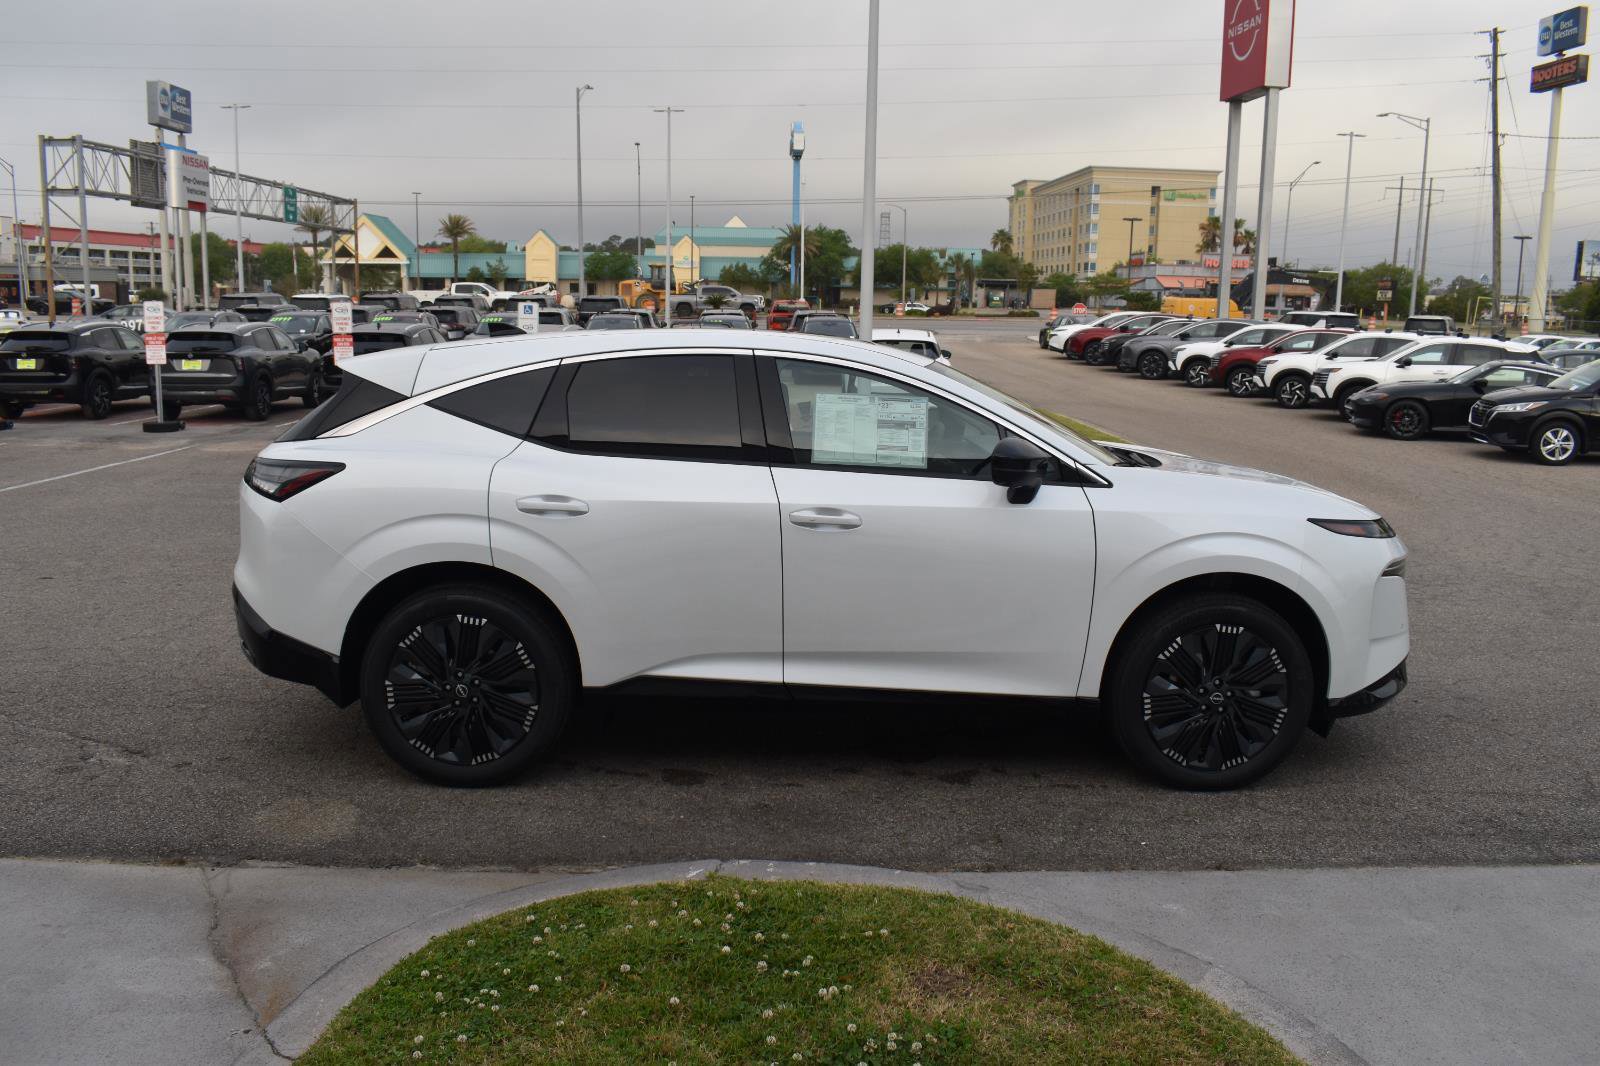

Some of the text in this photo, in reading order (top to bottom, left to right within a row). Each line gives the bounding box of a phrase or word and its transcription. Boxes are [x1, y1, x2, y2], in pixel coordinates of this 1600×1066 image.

[1228, 13, 1262, 39] NISSAN
[1560, 19, 1574, 30] Best
[1554, 27, 1579, 40] Western
[1533, 60, 1577, 83] HOOTERS
[175, 92, 187, 105] Best
[171, 101, 191, 116] Western
[182, 154, 209, 170] NISSAN
[1204, 258, 1249, 269] HOERS
